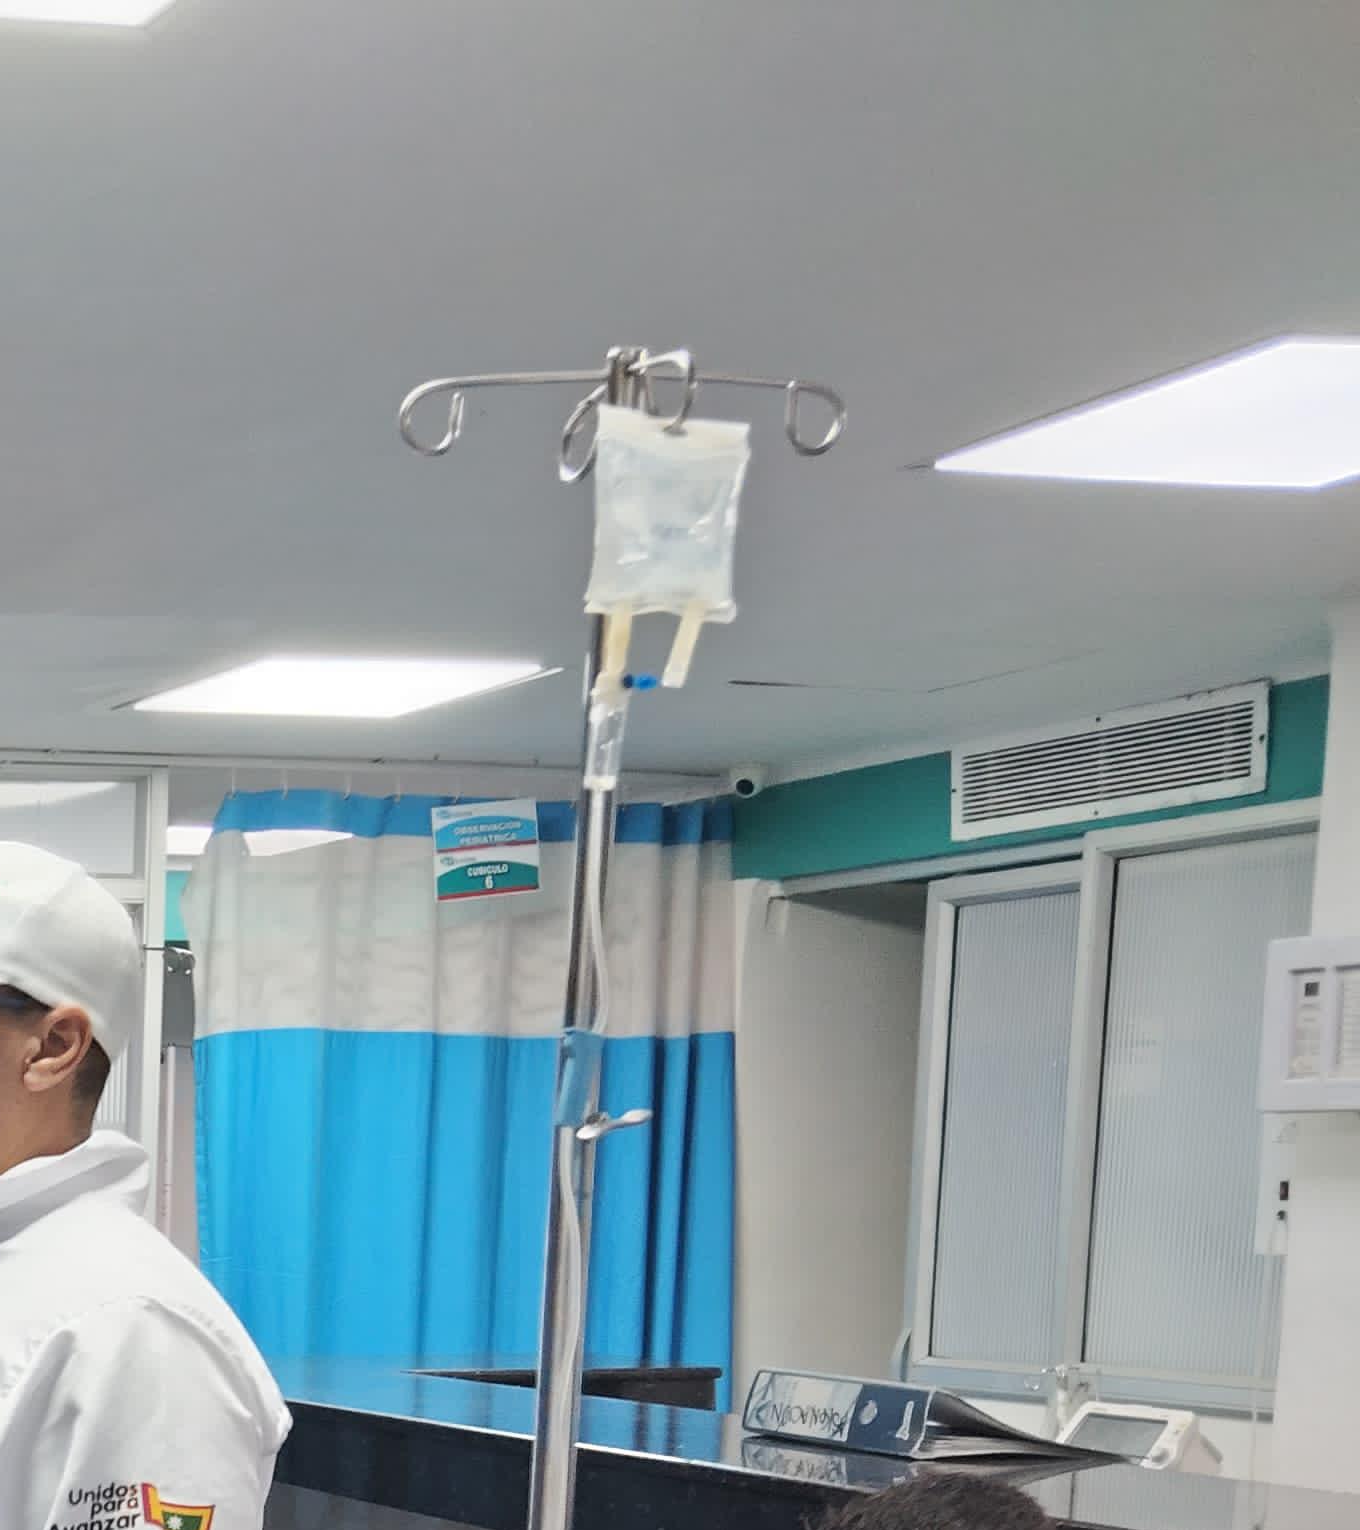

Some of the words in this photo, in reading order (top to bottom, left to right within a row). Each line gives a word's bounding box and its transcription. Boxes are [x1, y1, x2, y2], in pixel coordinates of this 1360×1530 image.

[485, 875, 494, 889] 6
[68, 1482, 138, 1505] Unidos
[91, 1496, 139, 1519] para
